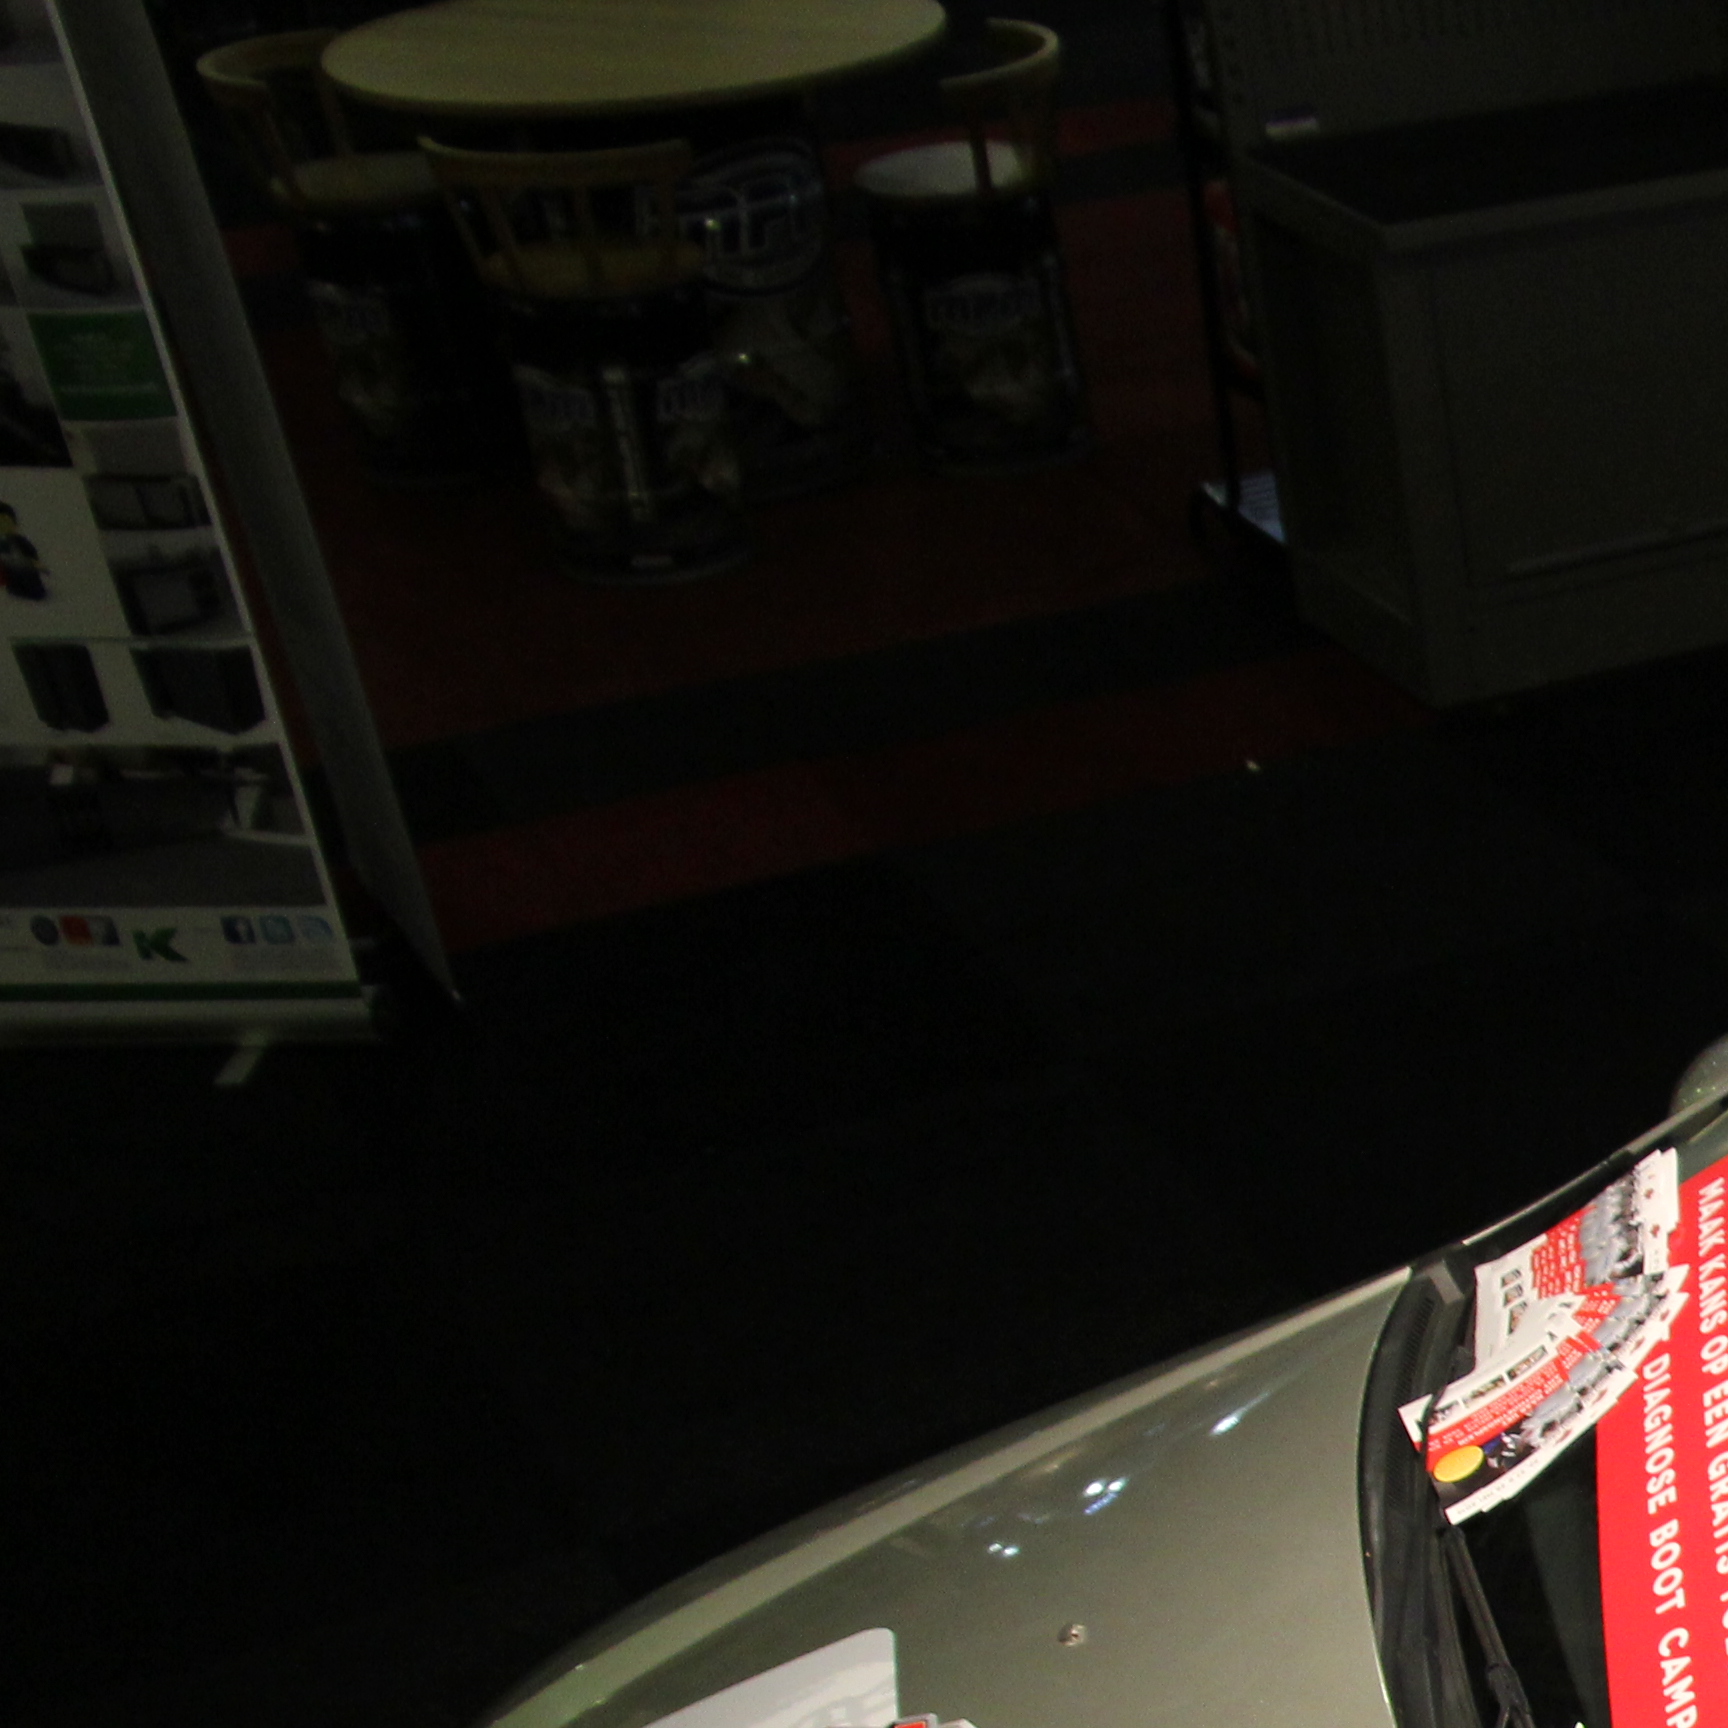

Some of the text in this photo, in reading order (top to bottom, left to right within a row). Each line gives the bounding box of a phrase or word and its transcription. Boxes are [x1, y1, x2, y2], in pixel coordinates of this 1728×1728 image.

[1699, 1177, 1726, 1256] MAAK
[1698, 1253, 1728, 1334] KANS
[1642, 1352, 1678, 1515] DIAGNOSE
[1649, 1519, 1686, 1615] BOOT
